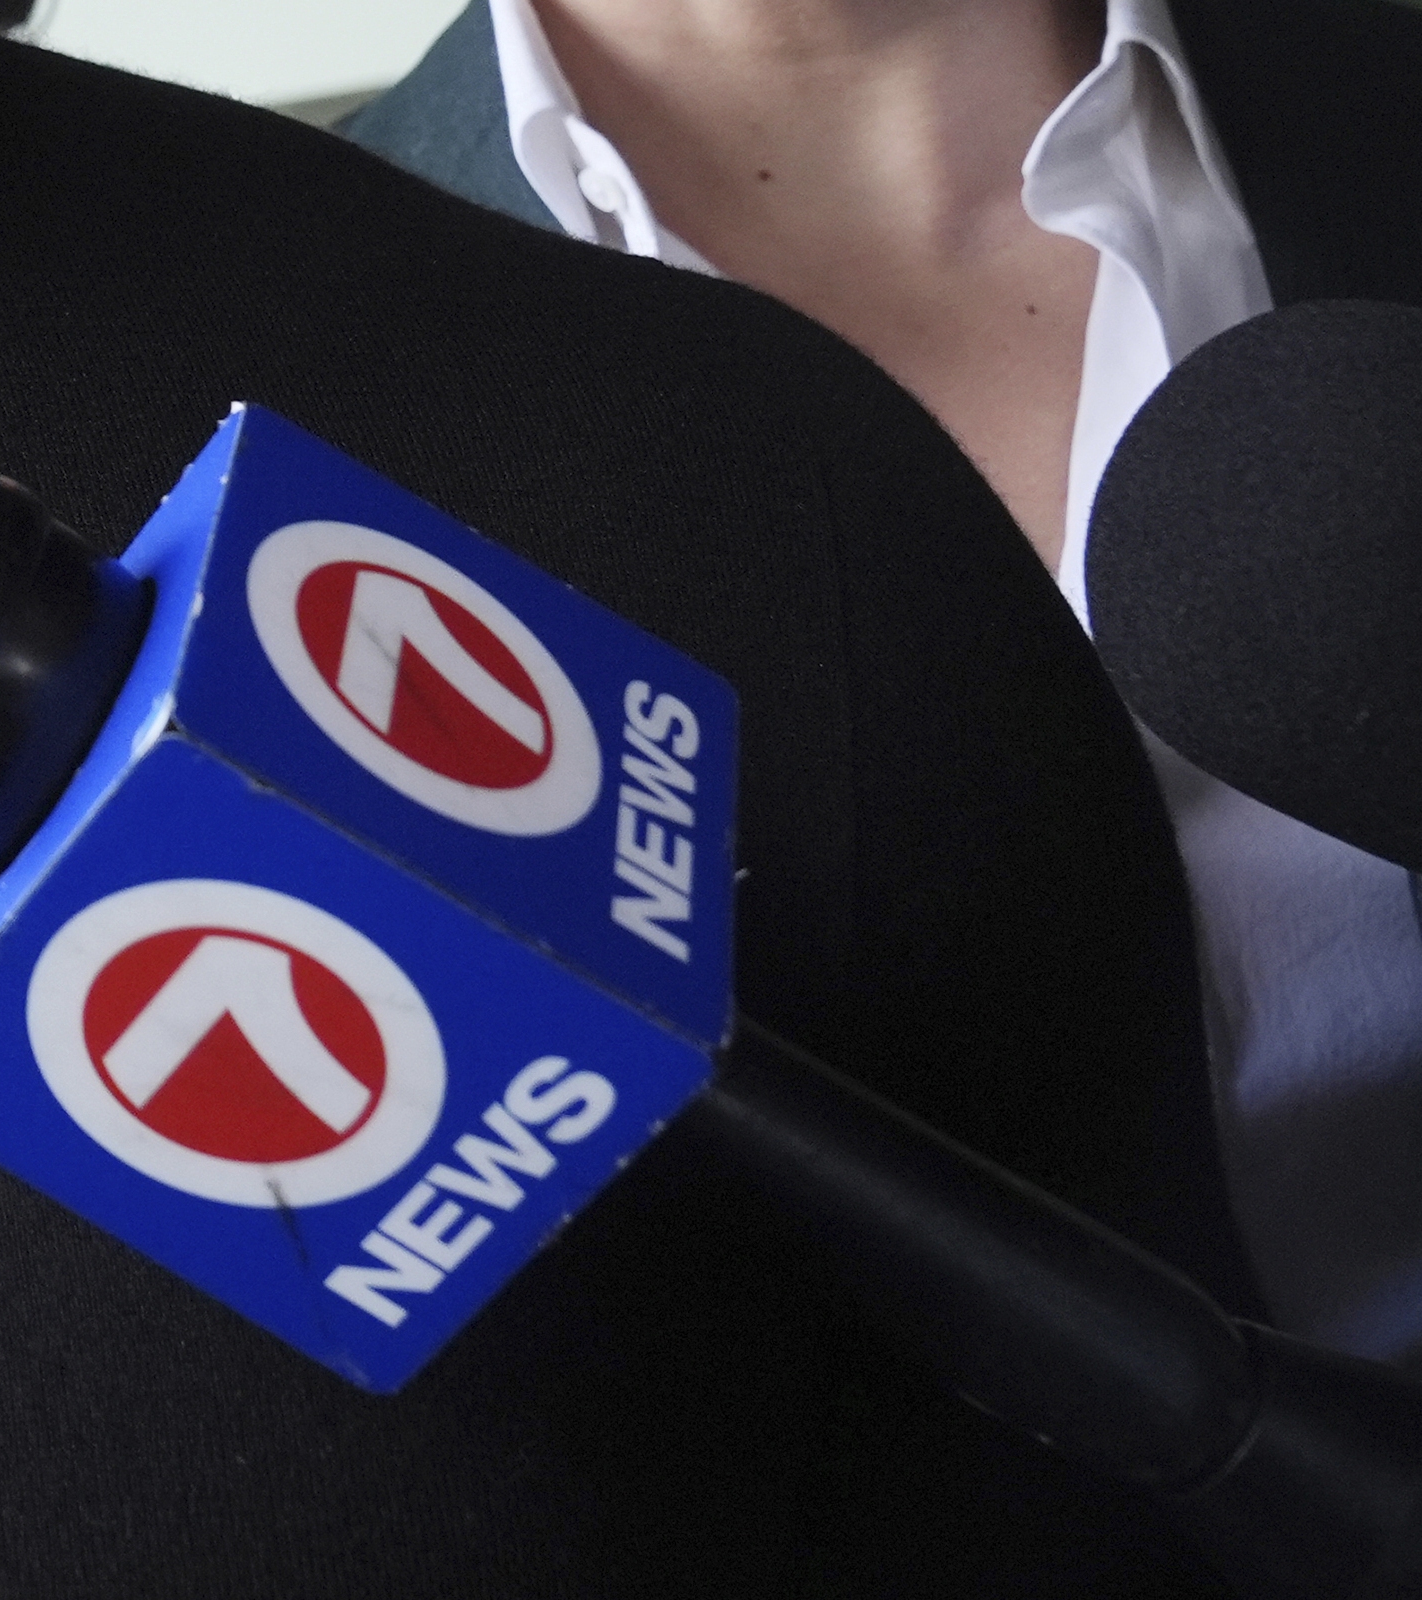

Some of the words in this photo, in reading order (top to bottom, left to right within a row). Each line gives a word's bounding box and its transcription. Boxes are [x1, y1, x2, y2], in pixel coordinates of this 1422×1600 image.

[335, 569, 546, 756] 7
[610, 680, 700, 962] NEWS
[101, 934, 373, 1136] 7
[323, 1055, 617, 1329] NEWS
